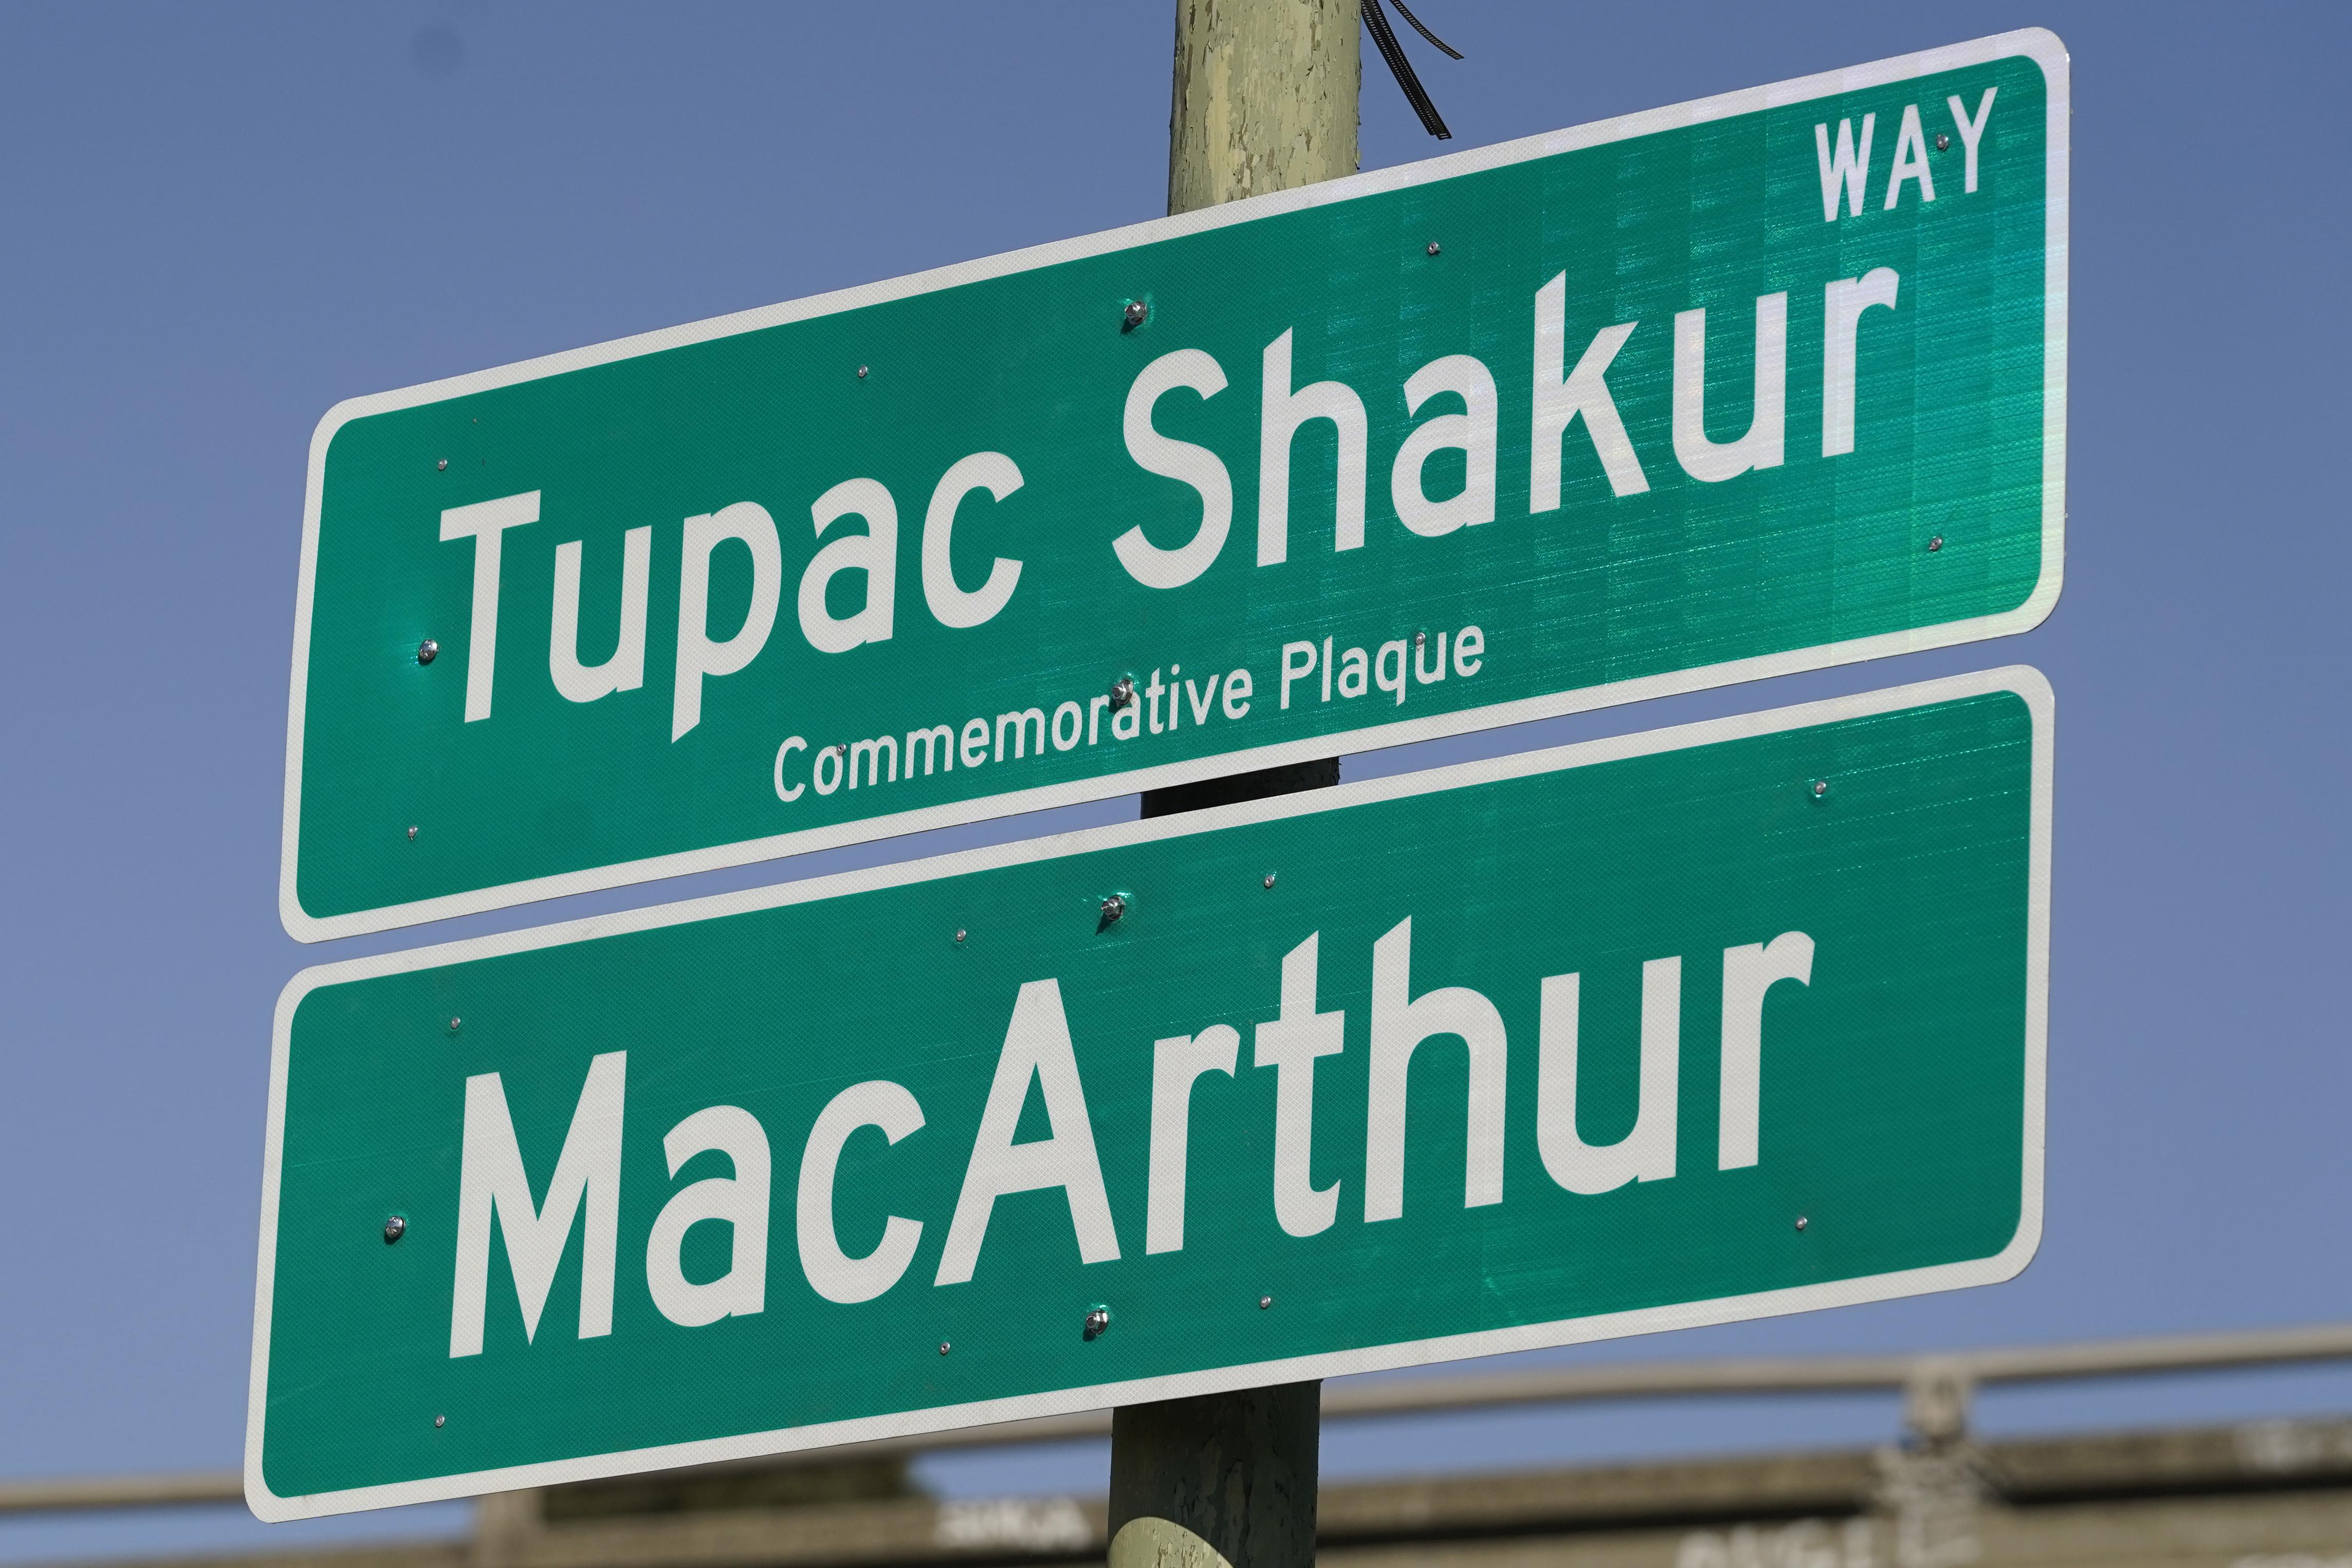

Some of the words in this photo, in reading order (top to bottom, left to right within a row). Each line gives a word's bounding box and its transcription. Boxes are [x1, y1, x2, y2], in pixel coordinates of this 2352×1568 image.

[1815, 86, 1998, 222] WAY
[439, 451, 1025, 744] Tupac
[1112, 267, 1900, 590] Shakur
[774, 663, 1253, 803] Commemorative
[1280, 624, 1485, 710] Plaque
[449, 915, 1815, 1359] MacArthur
